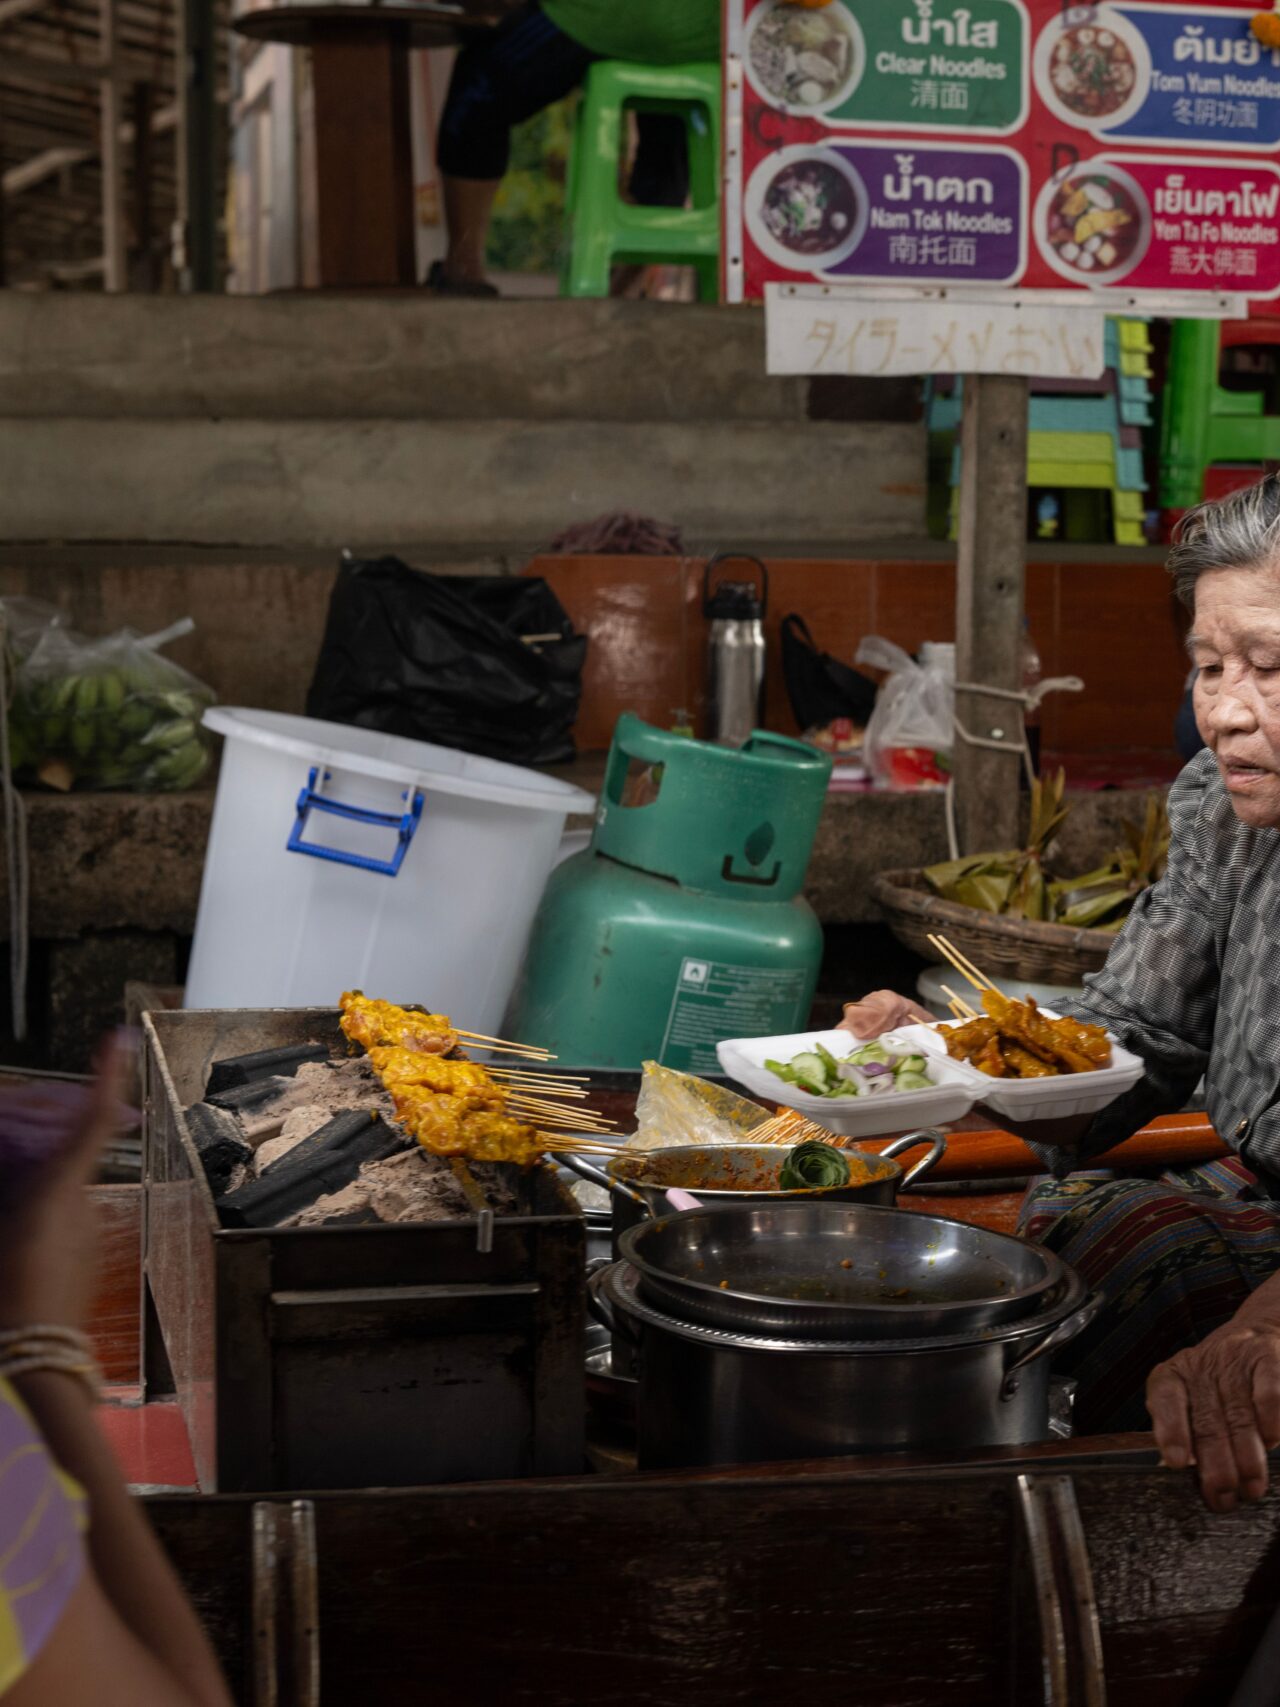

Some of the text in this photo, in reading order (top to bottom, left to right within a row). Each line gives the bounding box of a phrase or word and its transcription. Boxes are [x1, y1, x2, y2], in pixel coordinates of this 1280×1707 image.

[901, 0, 998, 48] น้ำใส
[875, 51, 1006, 80] Clear Noodles
[910, 79, 969, 110] 清面
[1150, 69, 1185, 92] Tom
[1187, 72, 1222, 94] Yum
[883, 154, 993, 204] น้ำตก
[1154, 174, 1280, 219] เย็นตาโฟ
[870, 206, 1013, 234] Nam Tok Noodles
[1154, 218, 1279, 245] Yen Ta Fo Noodles
[888, 233, 977, 266] 南托面
